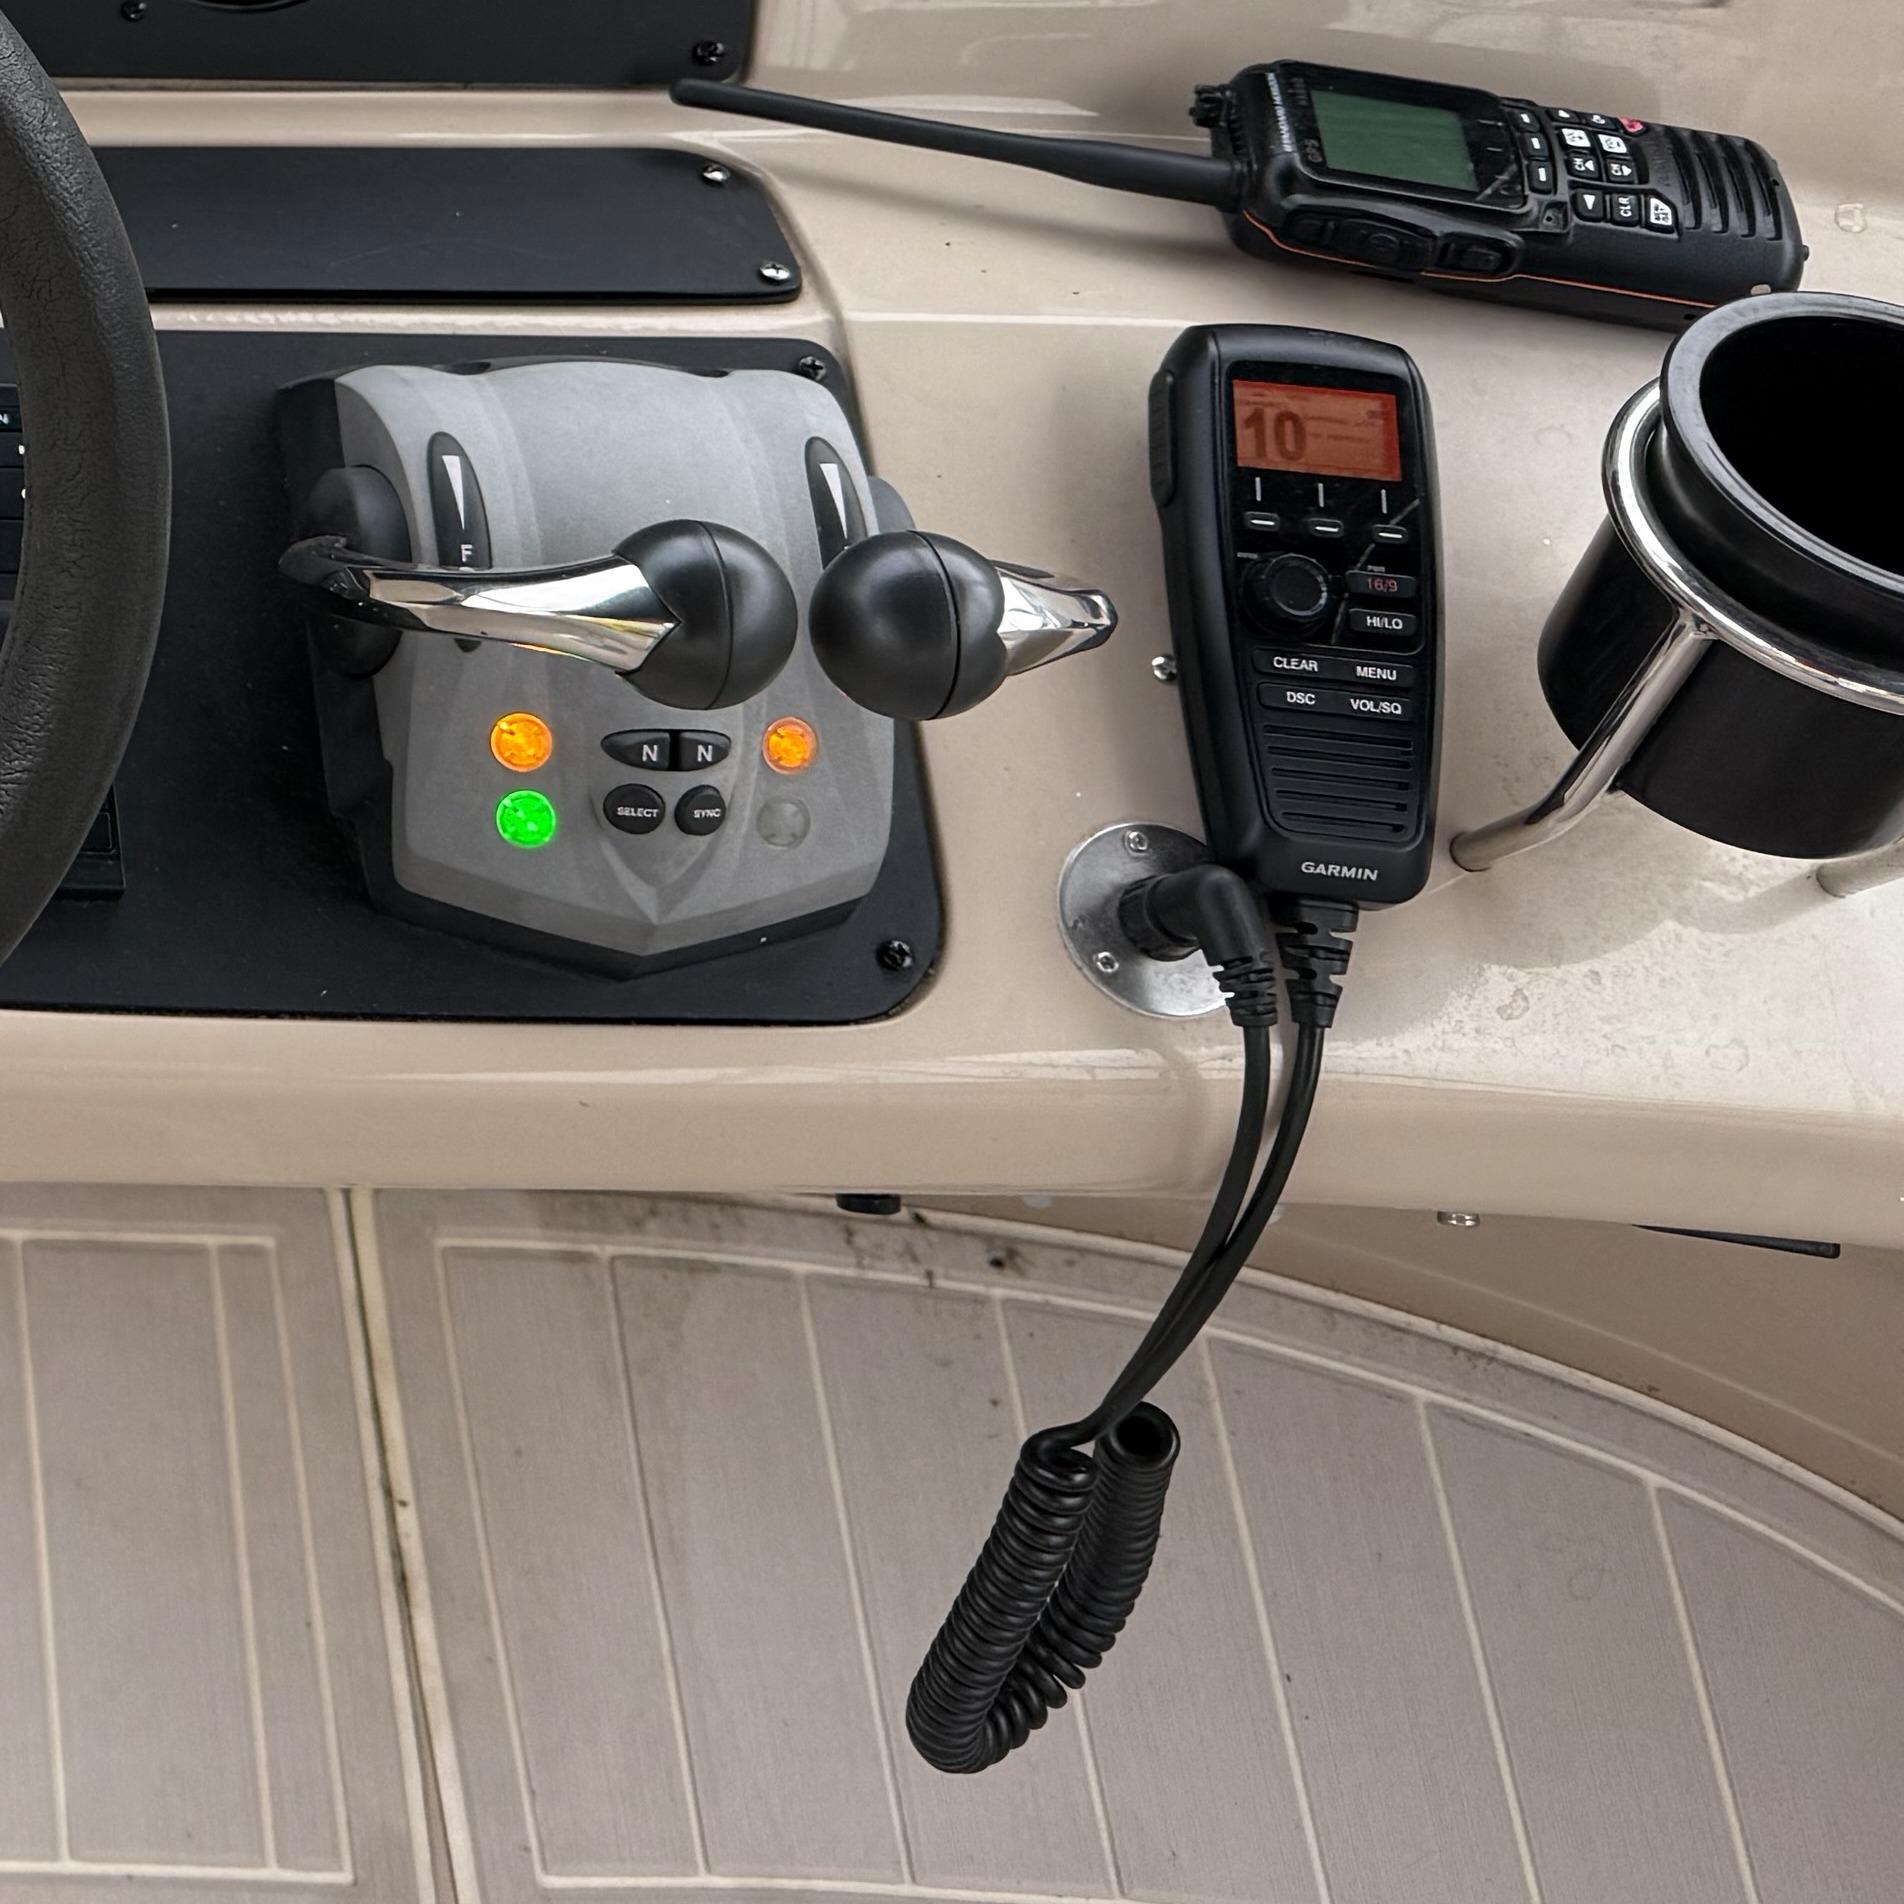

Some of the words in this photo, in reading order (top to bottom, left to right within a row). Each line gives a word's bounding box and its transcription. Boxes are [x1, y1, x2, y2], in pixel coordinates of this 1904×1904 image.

[1620, 197, 1632, 217] CLR
[1244, 407, 1307, 462] 10
[460, 543, 473, 563] F
[1366, 577, 1398, 594] 16/9
[1366, 615, 1403, 631] HI/LO
[1273, 657, 1318, 674] CLEAR
[1356, 666, 1397, 682] MENU
[1286, 691, 1316, 706] DSC
[1350, 698, 1402, 715] VOL/SQ
[642, 744, 658, 762] N
[697, 744, 713, 762] N
[616, 806, 659, 818] SELECT
[693, 808, 721, 819] SYNC
[1300, 860, 1379, 881] GARMIN
